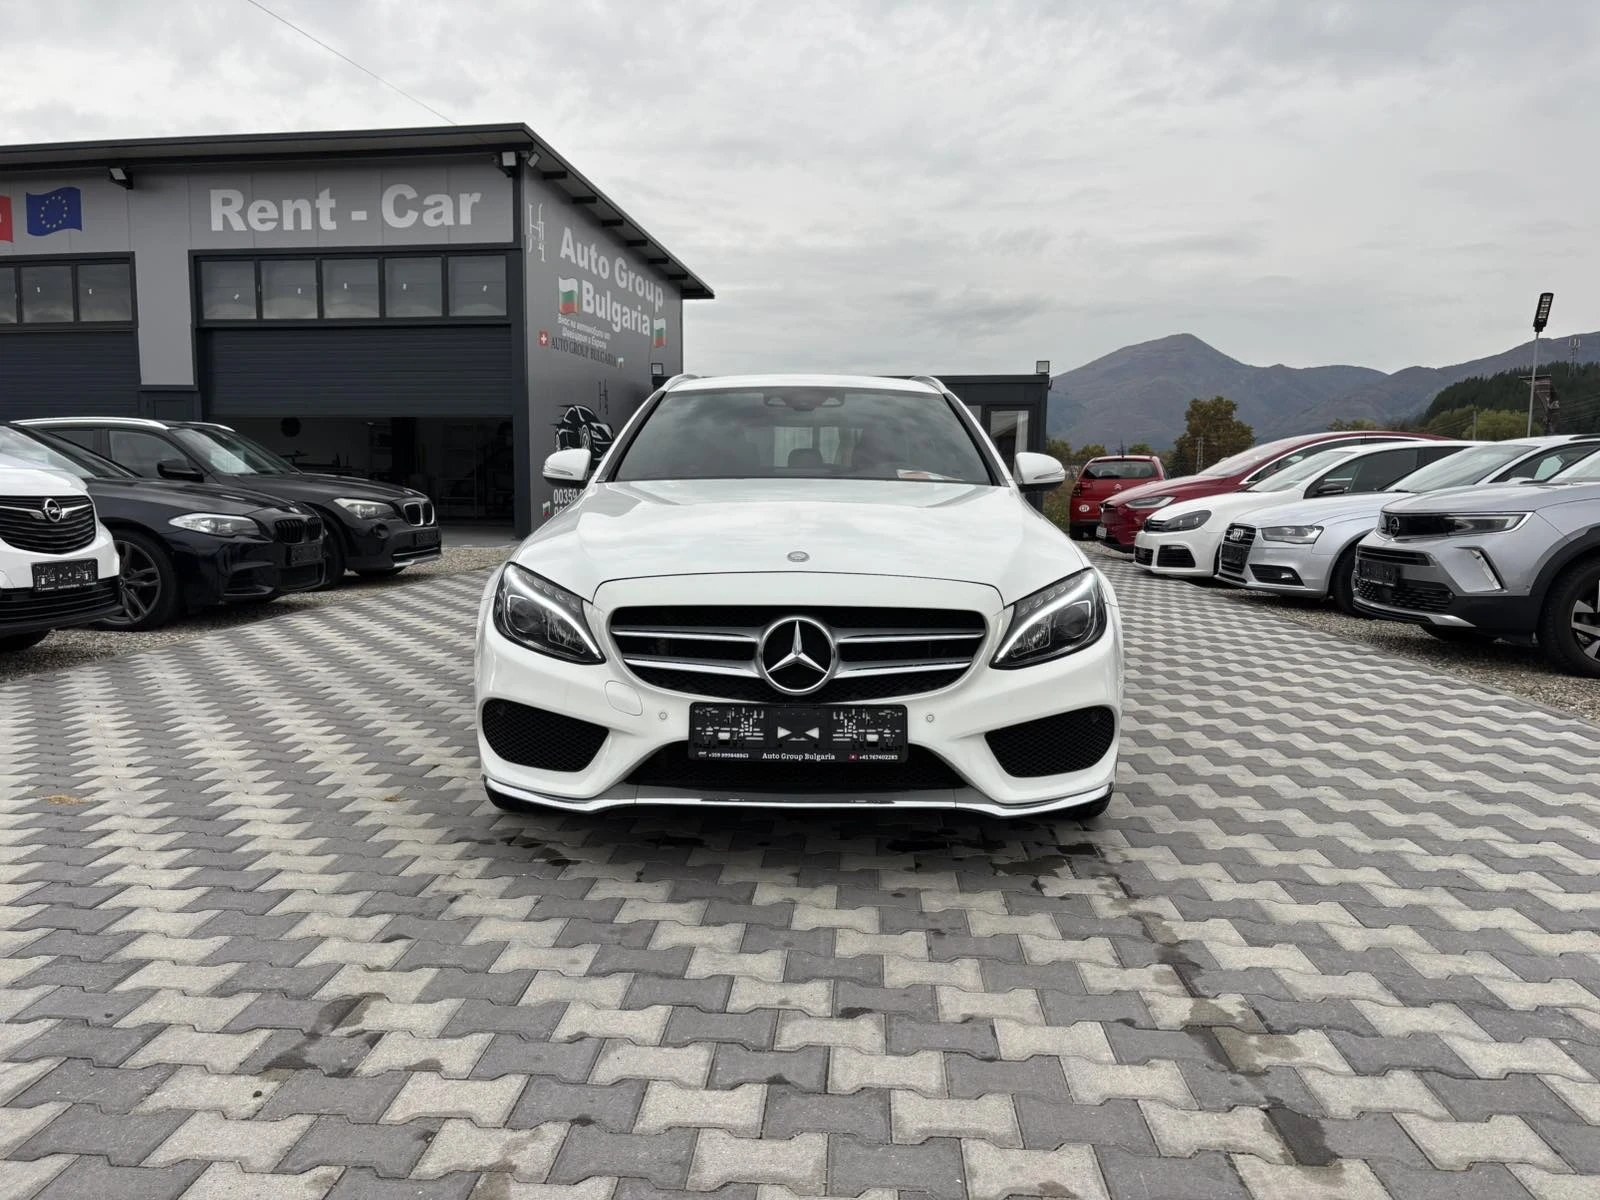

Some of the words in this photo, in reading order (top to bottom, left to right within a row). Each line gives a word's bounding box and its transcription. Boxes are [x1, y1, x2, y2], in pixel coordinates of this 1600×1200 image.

[209, 188, 337, 232] Rent
[381, 184, 482, 229] Car
[559, 227, 610, 279] Auto
[614, 257, 664, 312] Group
[582, 280, 650, 336] Bulgaria
[551, 337, 569, 352] AUTO
[762, 752, 780, 760] Auto
[781, 752, 803, 762] Group
[804, 752, 835, 762] Bulgaria
